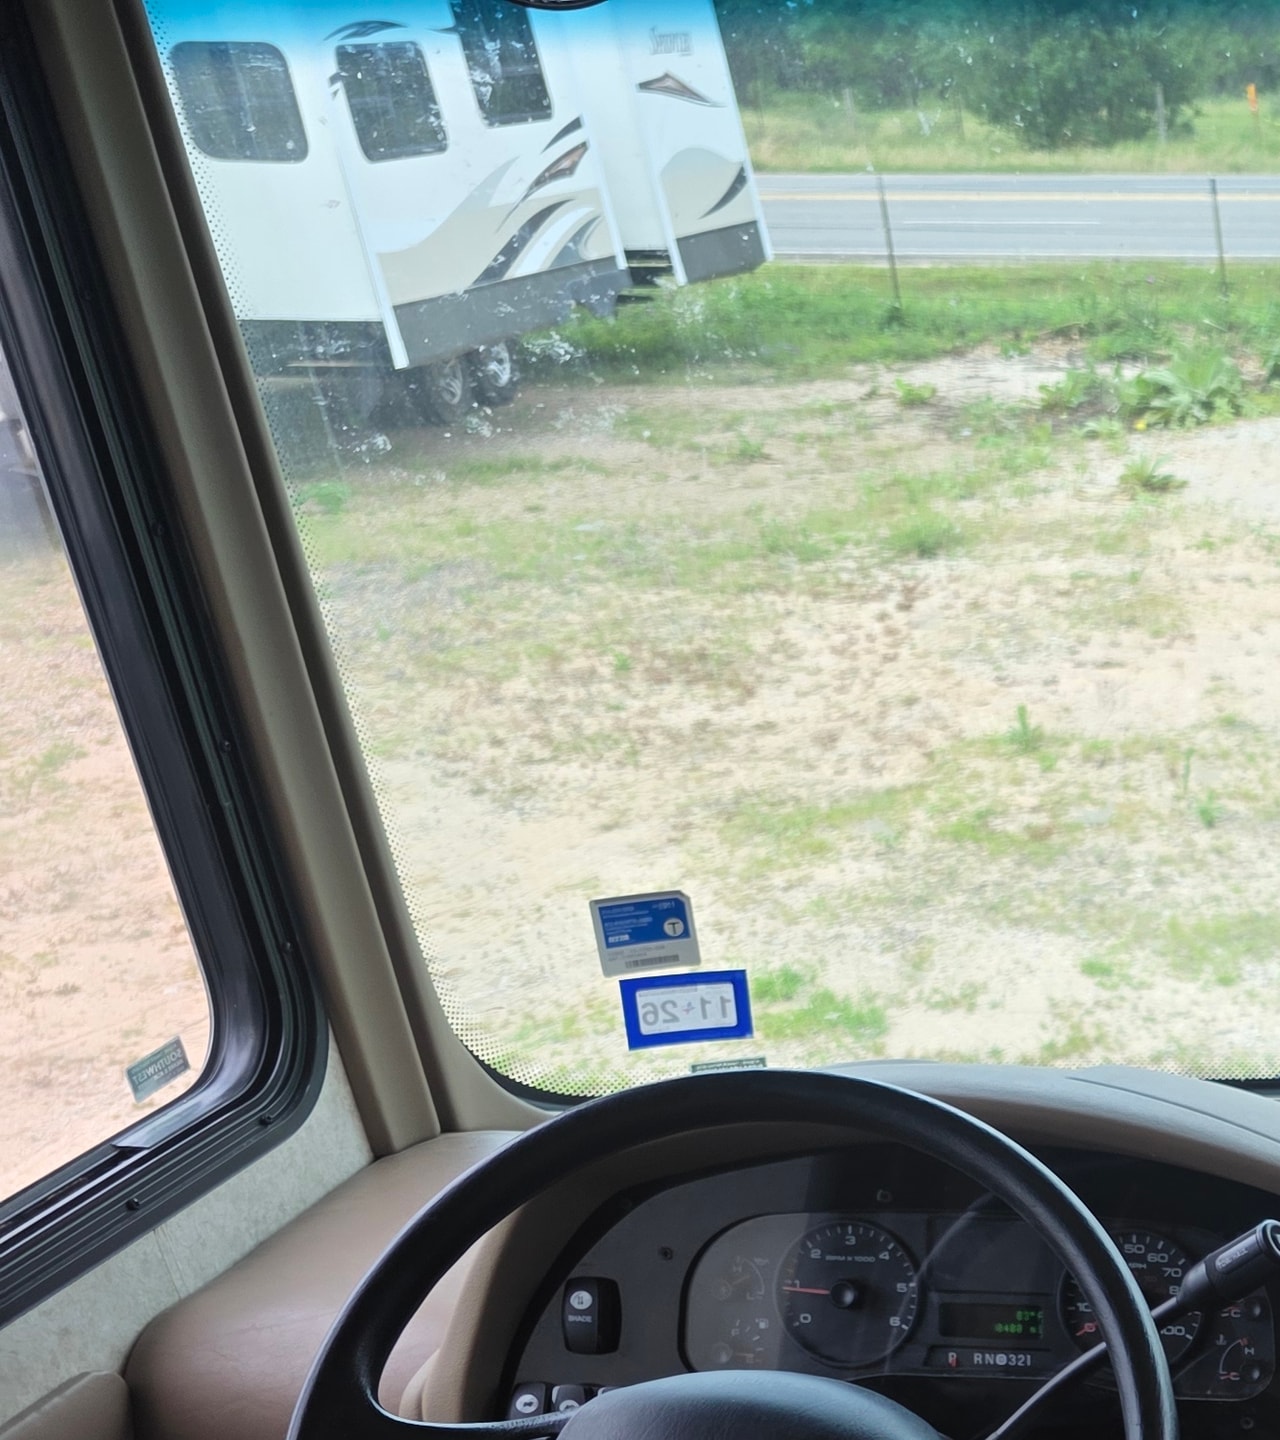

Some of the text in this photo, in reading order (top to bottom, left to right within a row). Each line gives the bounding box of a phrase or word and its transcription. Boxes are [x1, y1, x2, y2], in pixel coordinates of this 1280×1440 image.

[844, 1235, 857, 1246] 3
[810, 1248, 822, 1259] 2
[1123, 1243, 1146, 1254] 50
[879, 1250, 890, 1261] 4
[1146, 1252, 1169, 1263] 60
[1161, 1267, 1182, 1278] 70
[896, 1282, 908, 1292] 5
[799, 1313, 812, 1324] 0
[889, 1316, 901, 1326] 6
